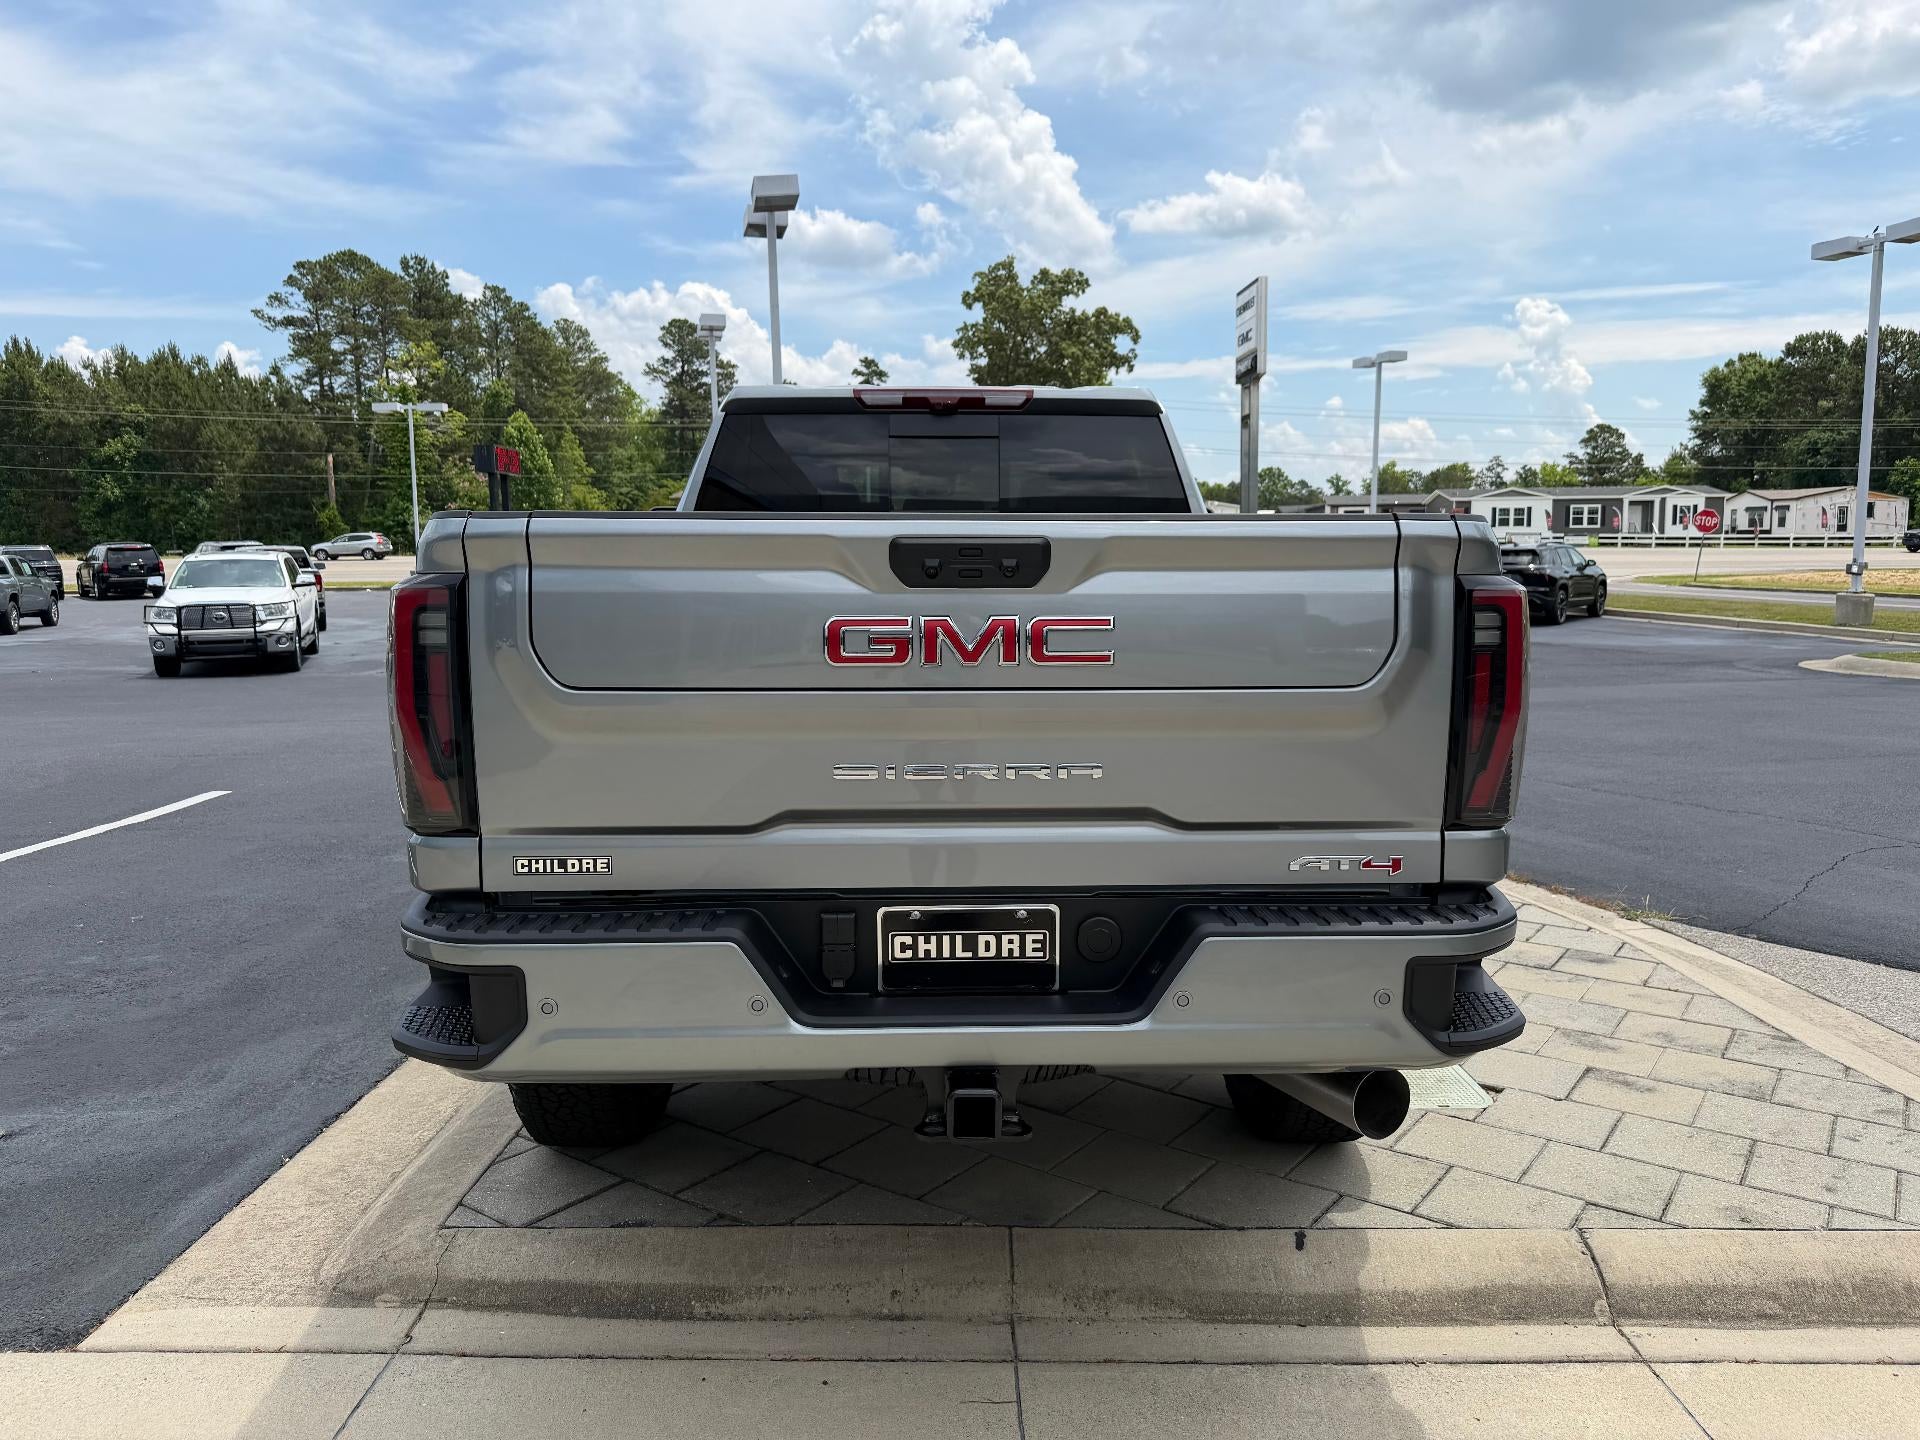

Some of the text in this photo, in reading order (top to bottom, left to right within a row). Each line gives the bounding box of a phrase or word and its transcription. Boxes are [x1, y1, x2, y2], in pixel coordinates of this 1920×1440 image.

[1694, 515, 1718, 527] STOP
[823, 614, 1115, 667] GMC
[832, 763, 1104, 780] SIERRA
[516, 858, 609, 873] CHILDRE
[1288, 855, 1404, 876] AT4
[893, 933, 1044, 959] CHILDRE
